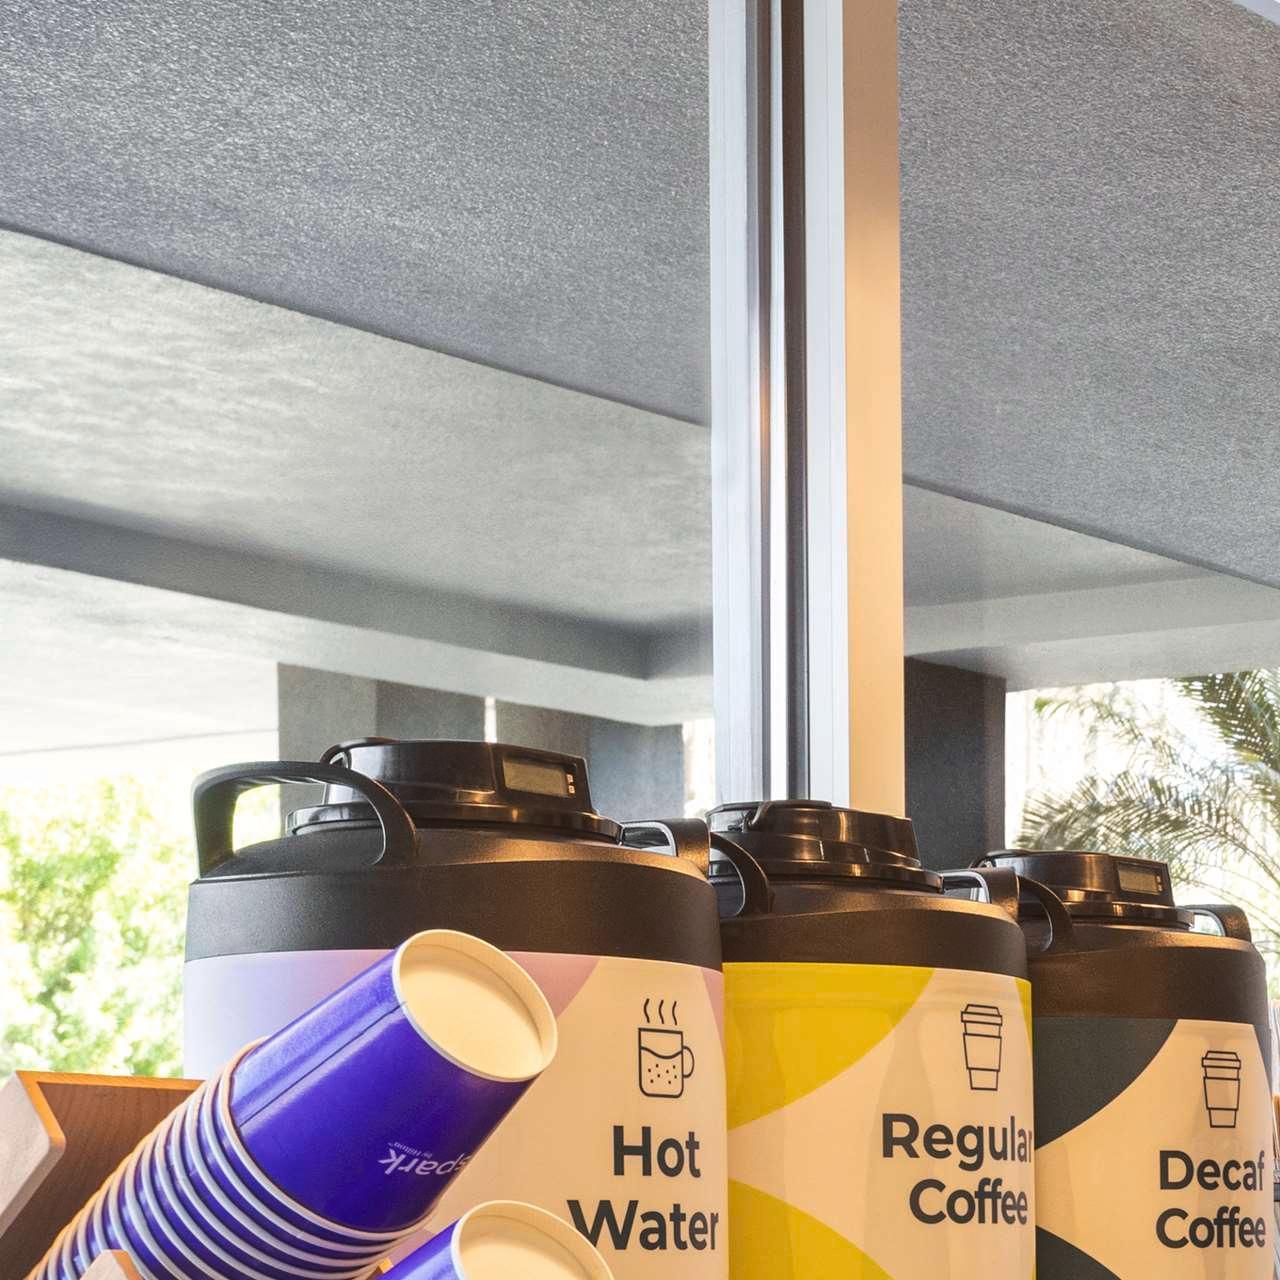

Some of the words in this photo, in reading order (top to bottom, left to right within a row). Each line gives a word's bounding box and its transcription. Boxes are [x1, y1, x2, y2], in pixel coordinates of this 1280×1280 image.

[613, 1125, 701, 1178] Hot
[882, 1113, 1033, 1171] Regular
[1159, 1150, 1265, 1191] Decaf
[566, 1199, 719, 1250] Water
[909, 1177, 1028, 1225] Coffee
[1156, 1205, 1266, 1249] Coffee
